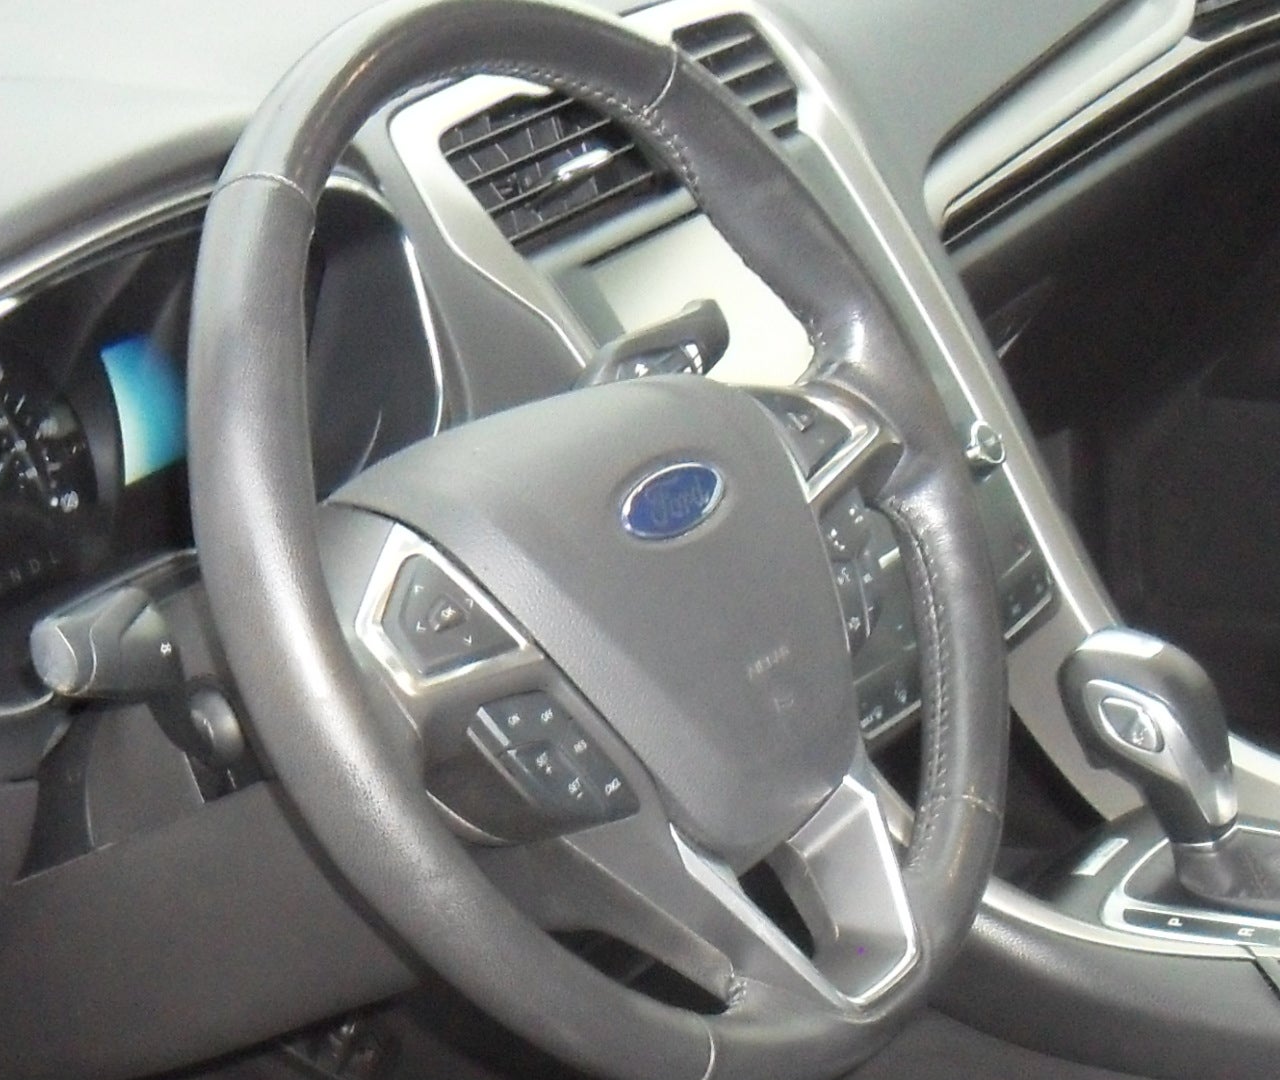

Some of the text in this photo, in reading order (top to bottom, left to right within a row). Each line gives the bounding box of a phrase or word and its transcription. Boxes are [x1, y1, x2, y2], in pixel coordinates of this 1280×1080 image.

[440, 605, 457, 618] OK
[568, 777, 580, 794] SET
[1168, 917, 1183, 928] P
[1237, 927, 1255, 938] R
